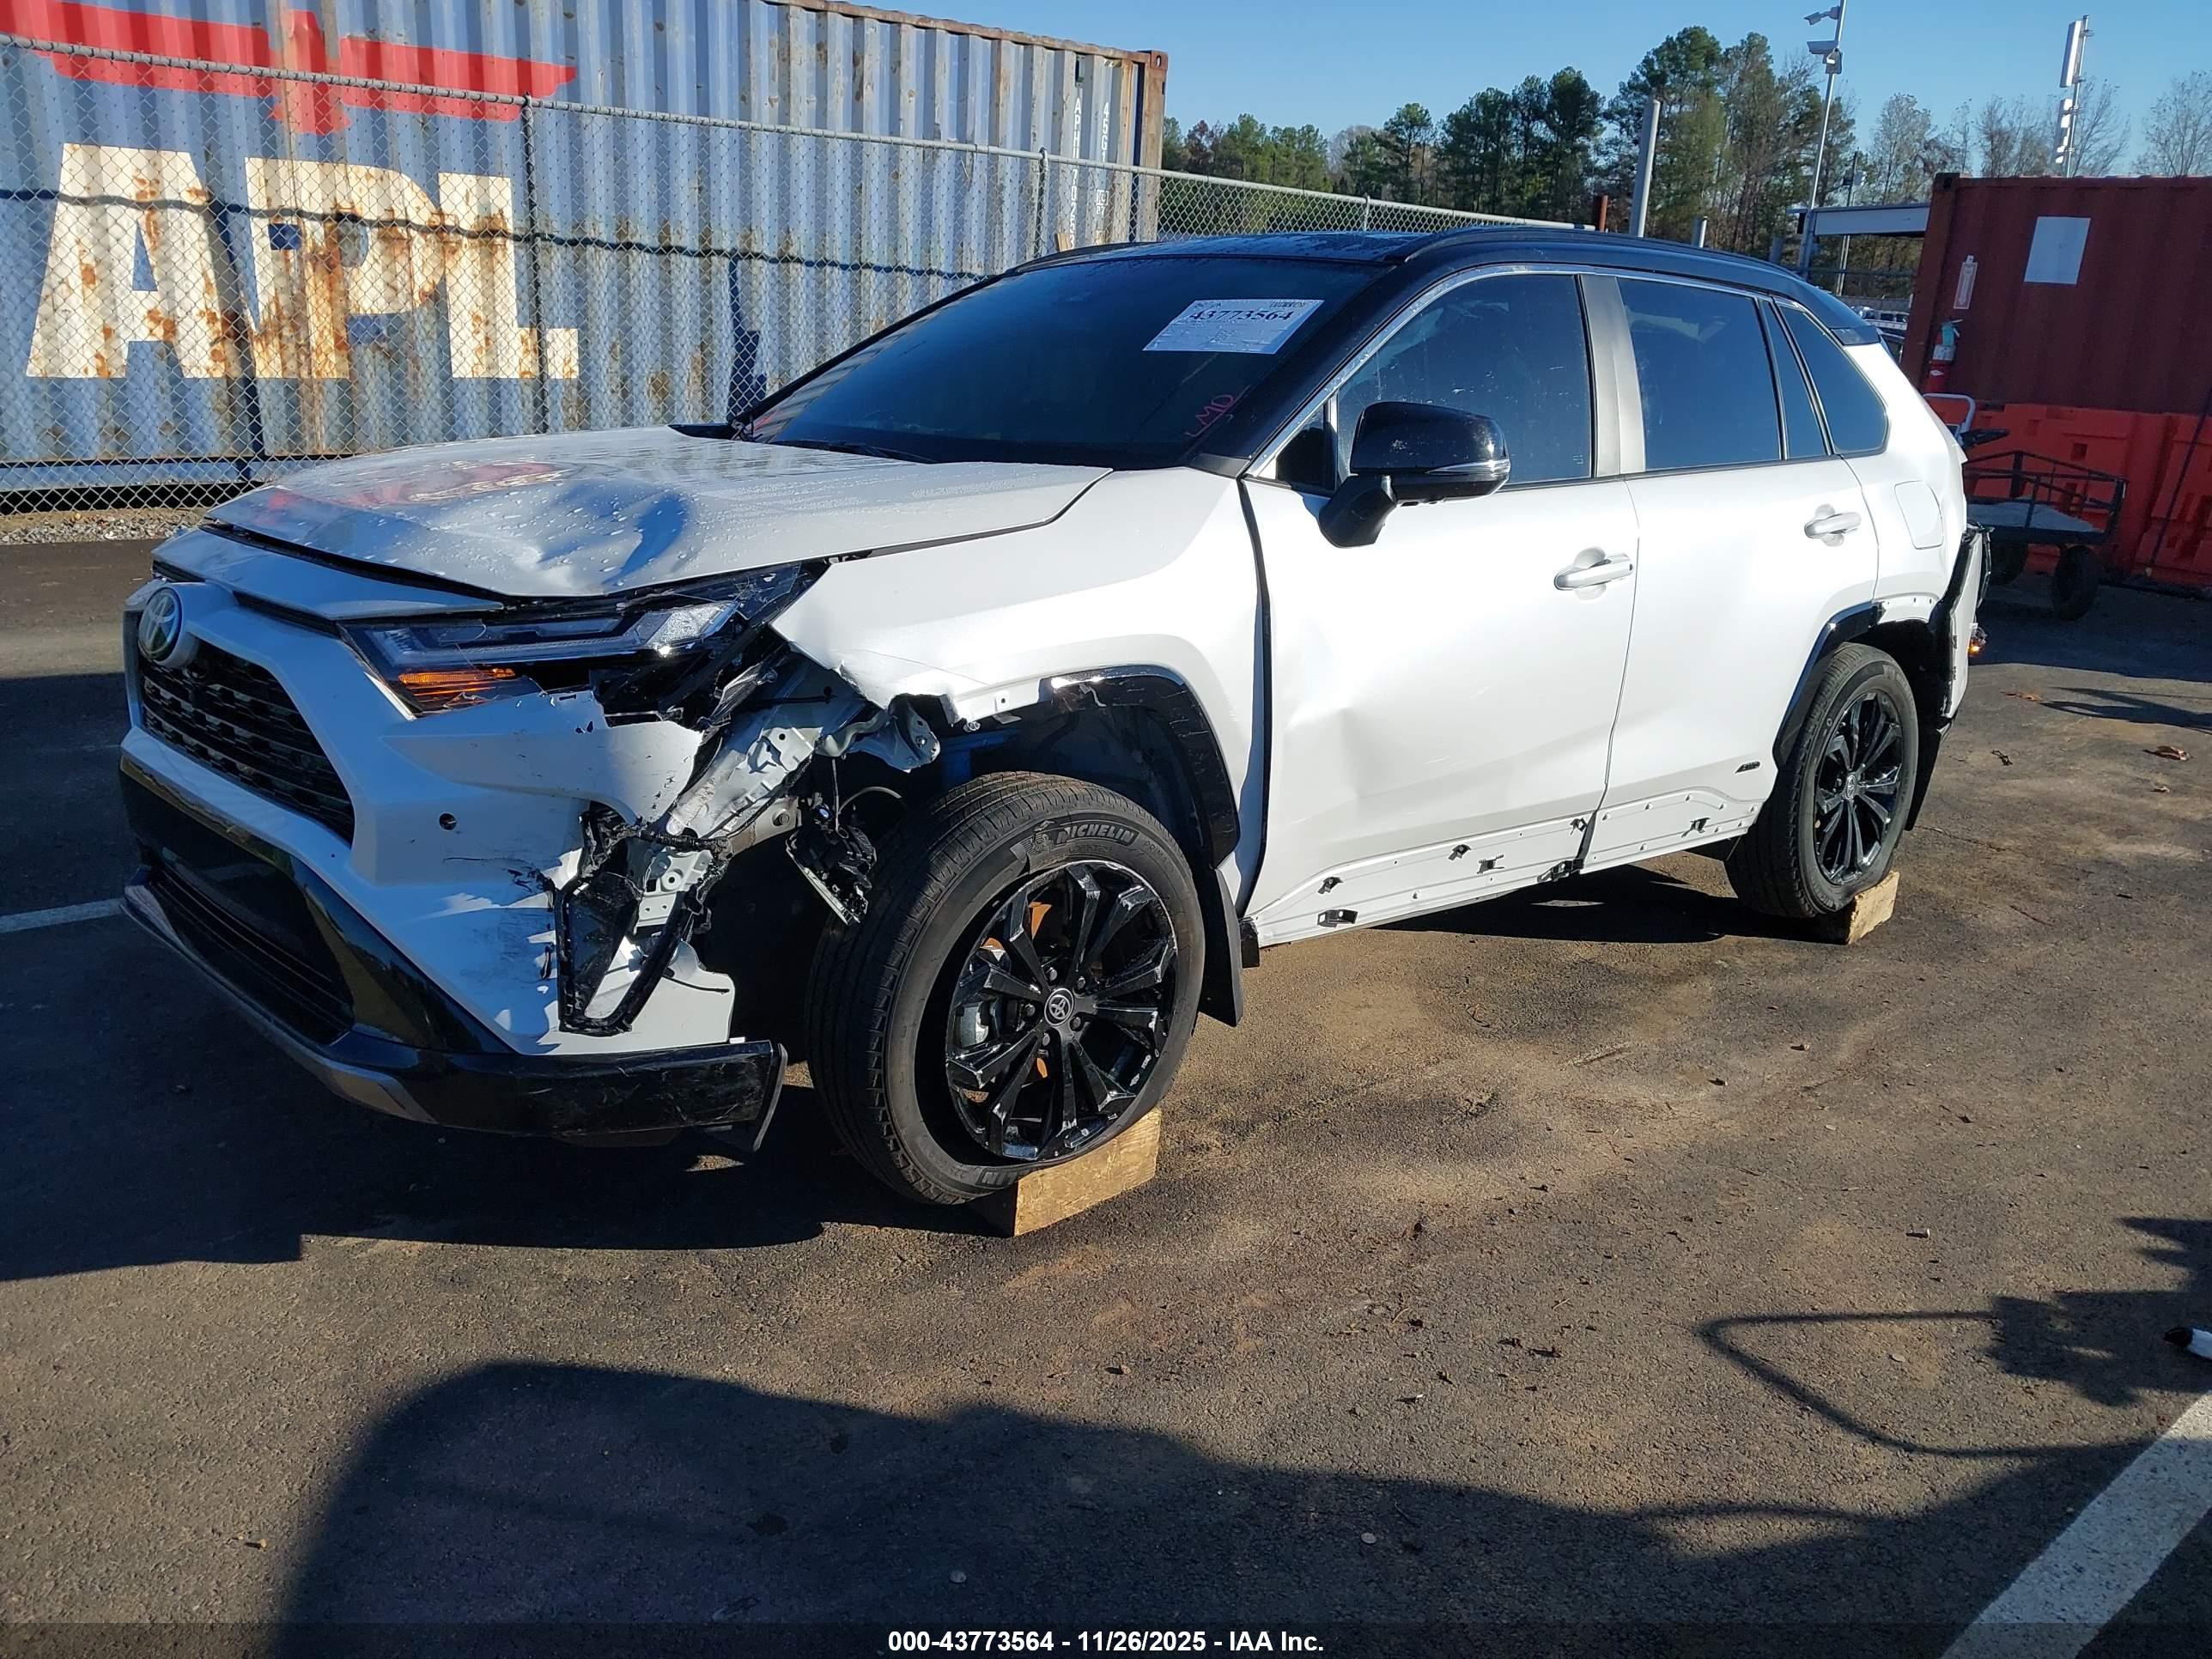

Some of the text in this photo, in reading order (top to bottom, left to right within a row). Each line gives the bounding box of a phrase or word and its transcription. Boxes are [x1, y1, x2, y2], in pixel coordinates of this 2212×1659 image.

[27, 143, 579, 380] APL
[1189, 310, 1294, 320] 43773564
[1057, 823, 1135, 844] MICHELIN
